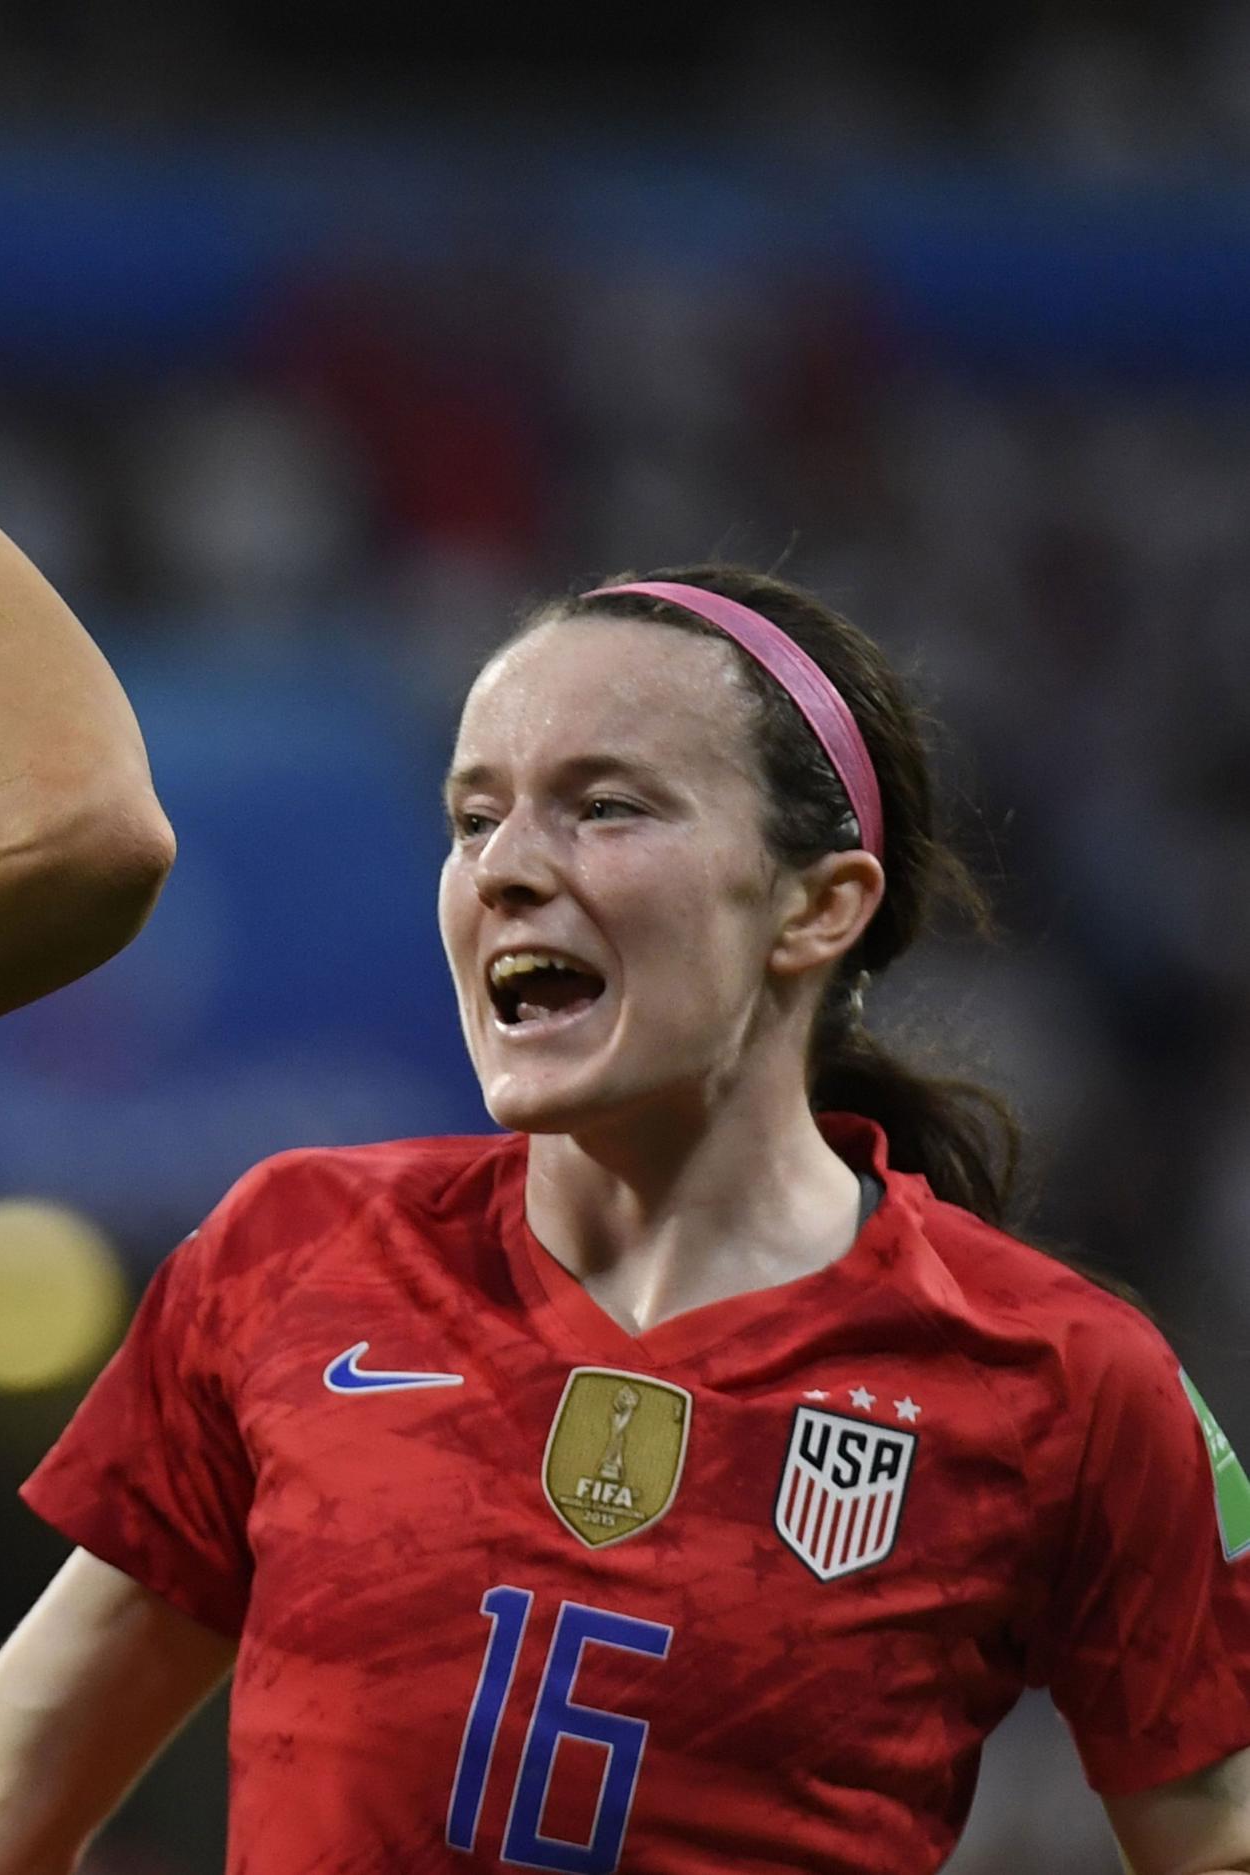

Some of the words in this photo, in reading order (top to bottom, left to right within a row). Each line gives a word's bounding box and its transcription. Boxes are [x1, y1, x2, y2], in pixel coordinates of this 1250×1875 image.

[799, 1419, 904, 1490] USA
[576, 1477, 633, 1508] FIFA
[446, 1584, 675, 1875] 16
